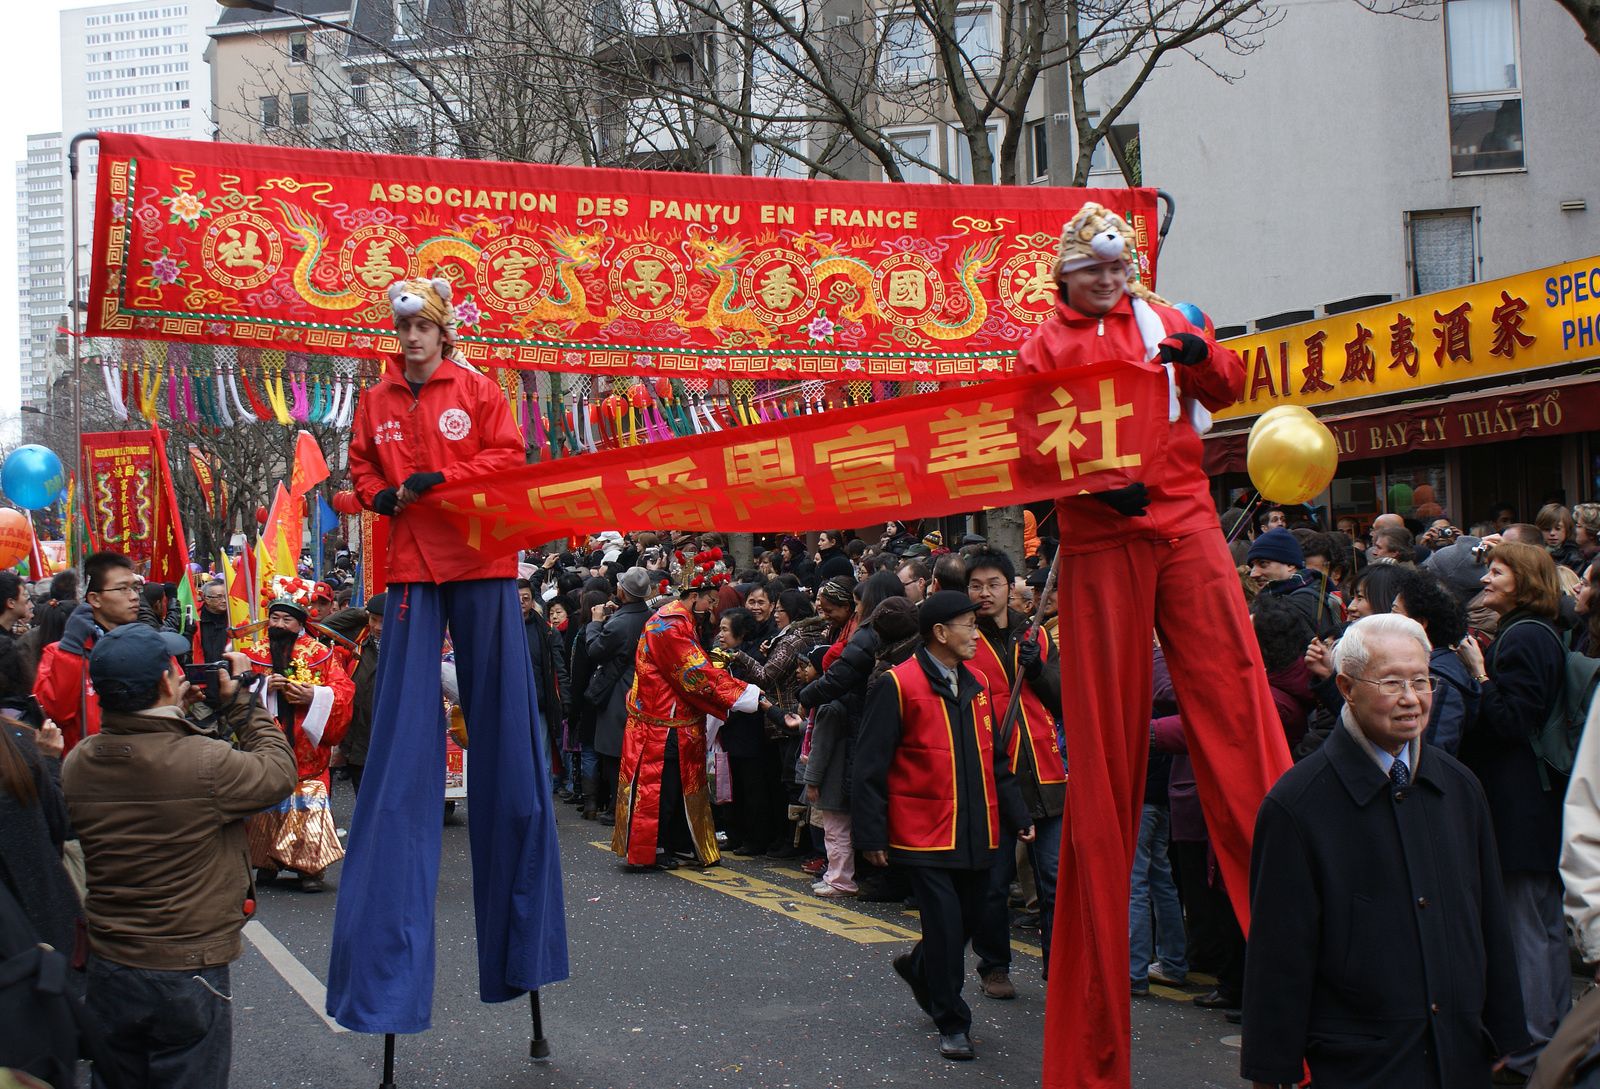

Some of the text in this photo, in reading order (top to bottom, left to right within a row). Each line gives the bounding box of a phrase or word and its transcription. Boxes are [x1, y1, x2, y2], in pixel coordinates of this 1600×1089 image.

[369, 183, 918, 229] ASSOCIATION DES PANYU EN FRANCE
[1299, 290, 1537, 395] 夏威夷酒家
[1370, 421, 1408, 450] BAY
[1420, 408, 1447, 442] LÝ
[1458, 400, 1518, 437] THÁI
